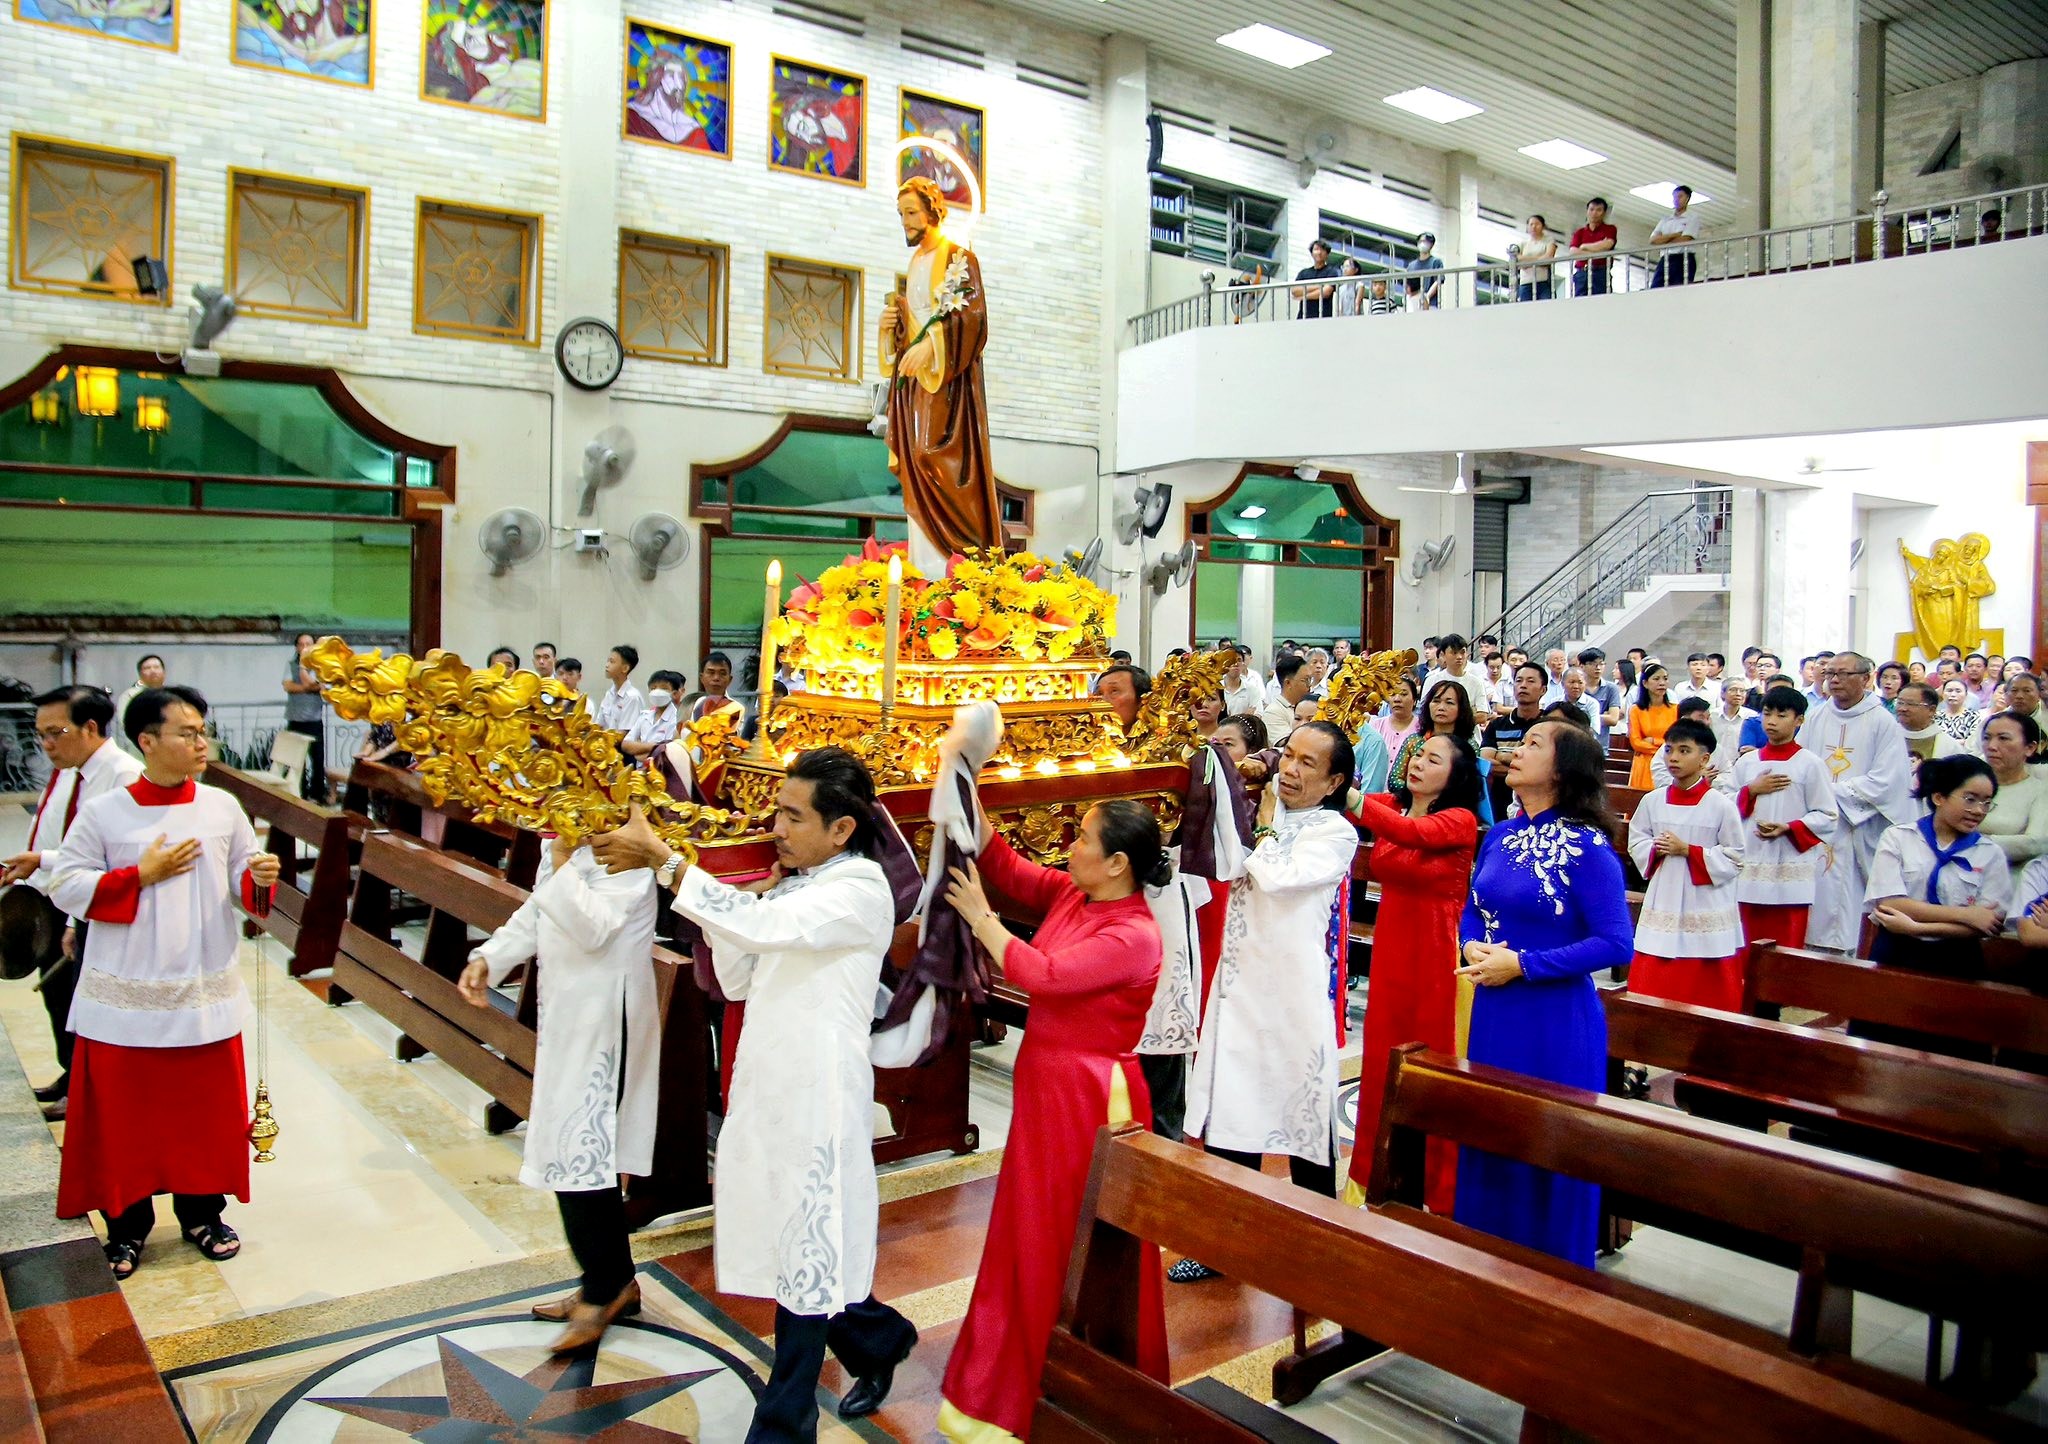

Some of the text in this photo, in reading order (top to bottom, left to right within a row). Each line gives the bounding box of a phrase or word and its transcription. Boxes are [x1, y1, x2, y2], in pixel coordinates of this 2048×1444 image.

[575, 328, 582, 336] 11
[585, 327, 594, 335] 12
[568, 337, 577, 345] 10
